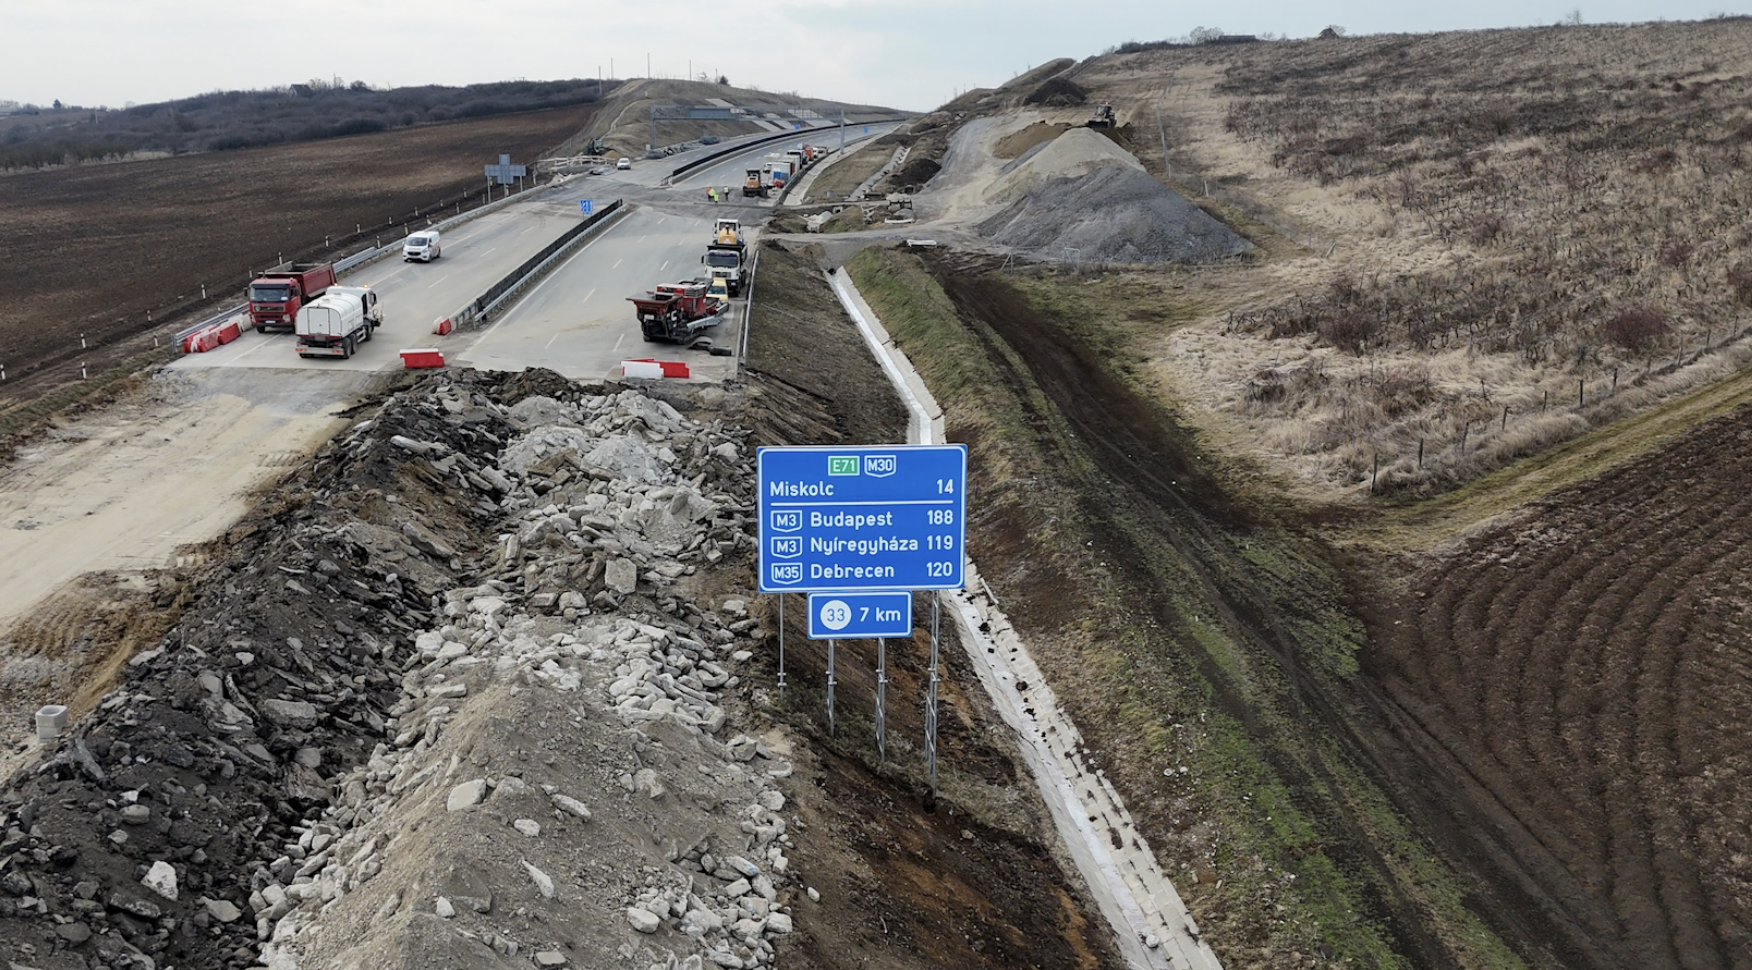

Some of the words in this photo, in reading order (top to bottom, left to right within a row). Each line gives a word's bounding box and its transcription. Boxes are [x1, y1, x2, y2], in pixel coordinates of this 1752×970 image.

[833, 460, 854, 472] E71
[867, 459, 893, 472] M30
[770, 481, 833, 496] Miskolc
[937, 479, 953, 494] 14
[777, 514, 796, 526] M3
[811, 512, 892, 530] Budapest
[927, 510, 953, 525] 188
[777, 541, 796, 552] M3
[811, 536, 918, 555] Nyíregyháza
[927, 535, 953, 550] 119
[774, 567, 799, 580] M35
[811, 564, 894, 578] Debrecen
[927, 562, 952, 576] 120
[827, 608, 845, 622] 33
[860, 607, 869, 621] 7
[876, 607, 900, 621] km
